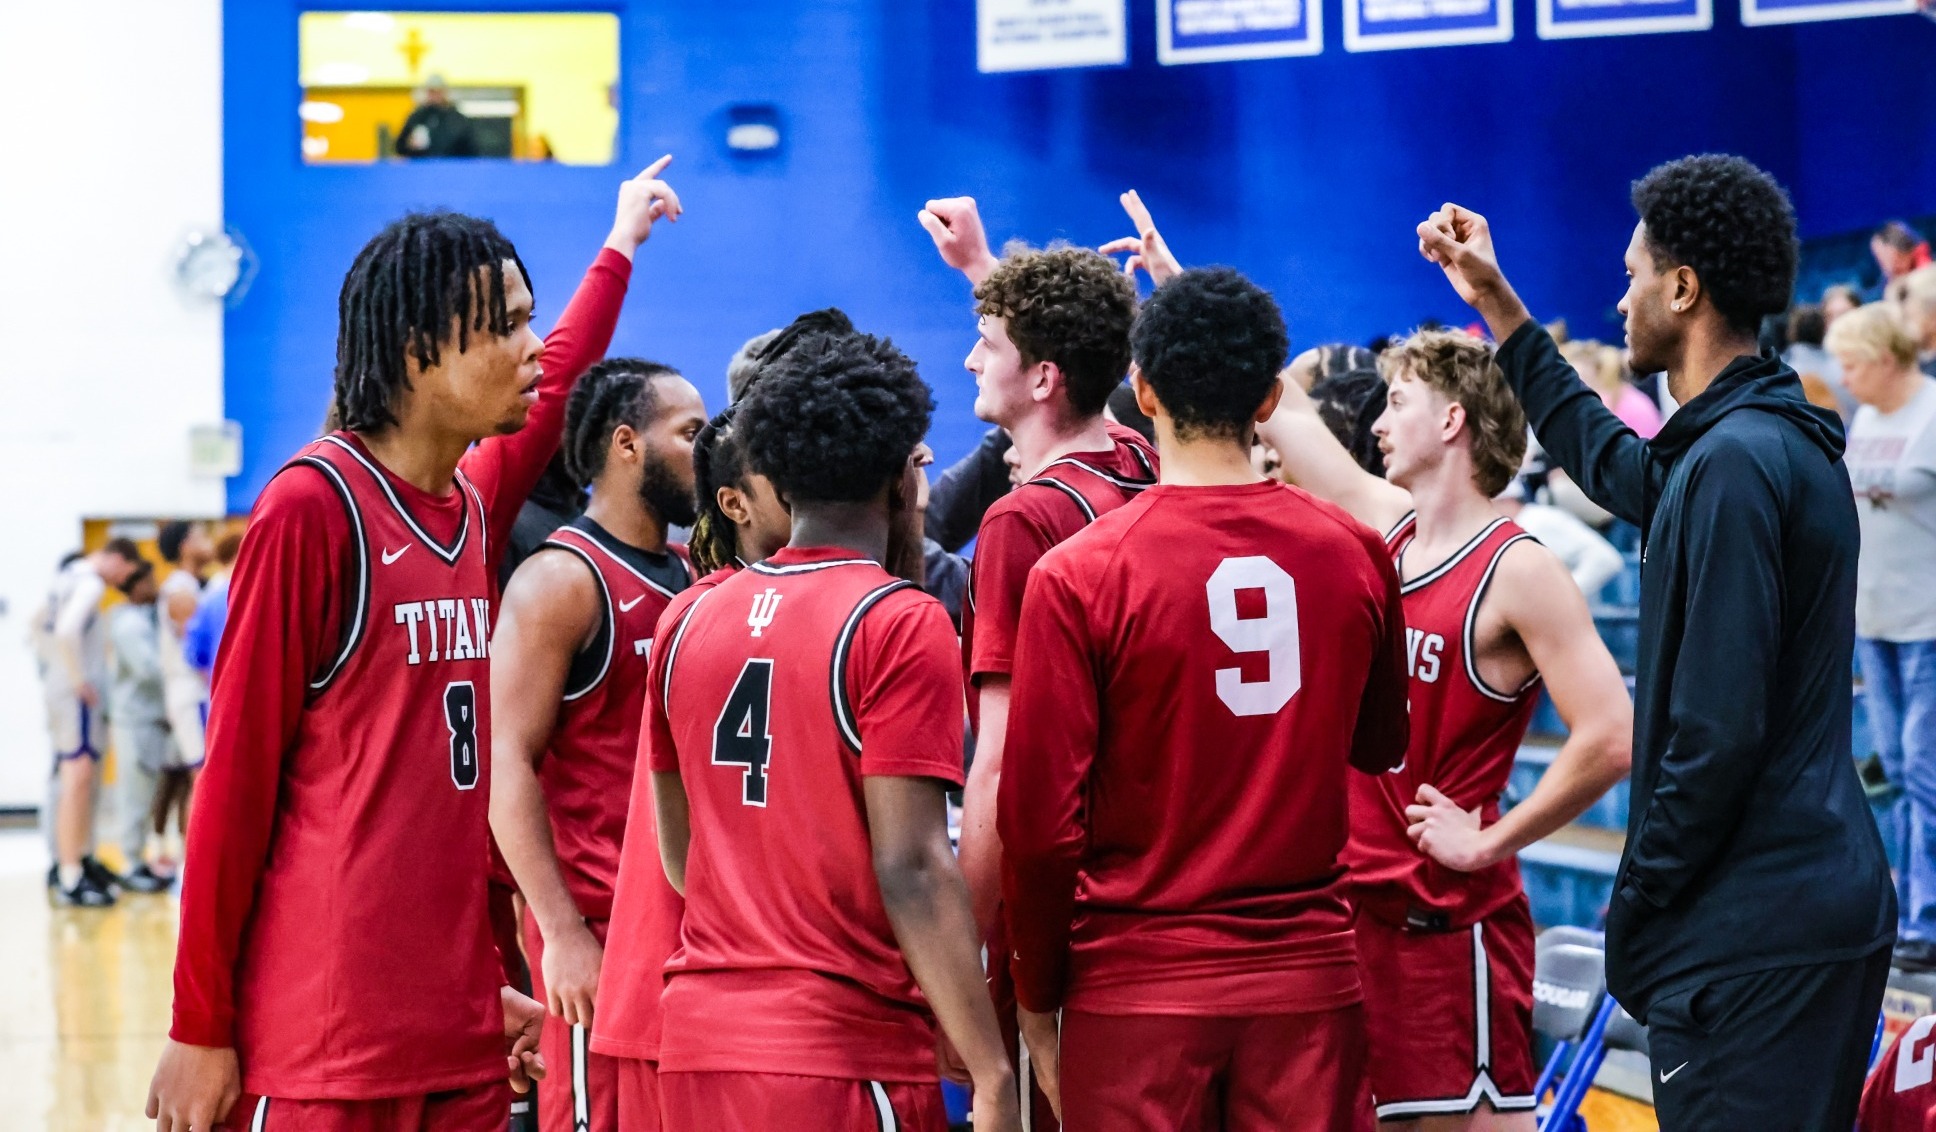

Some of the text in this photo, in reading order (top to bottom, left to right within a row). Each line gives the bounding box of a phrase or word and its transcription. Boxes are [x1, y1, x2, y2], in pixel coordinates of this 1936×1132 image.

[1206, 555, 1301, 717] 9
[443, 680, 479, 791] 8
[711, 657, 774, 808] 4
[1893, 1013, 1936, 1094] 2
